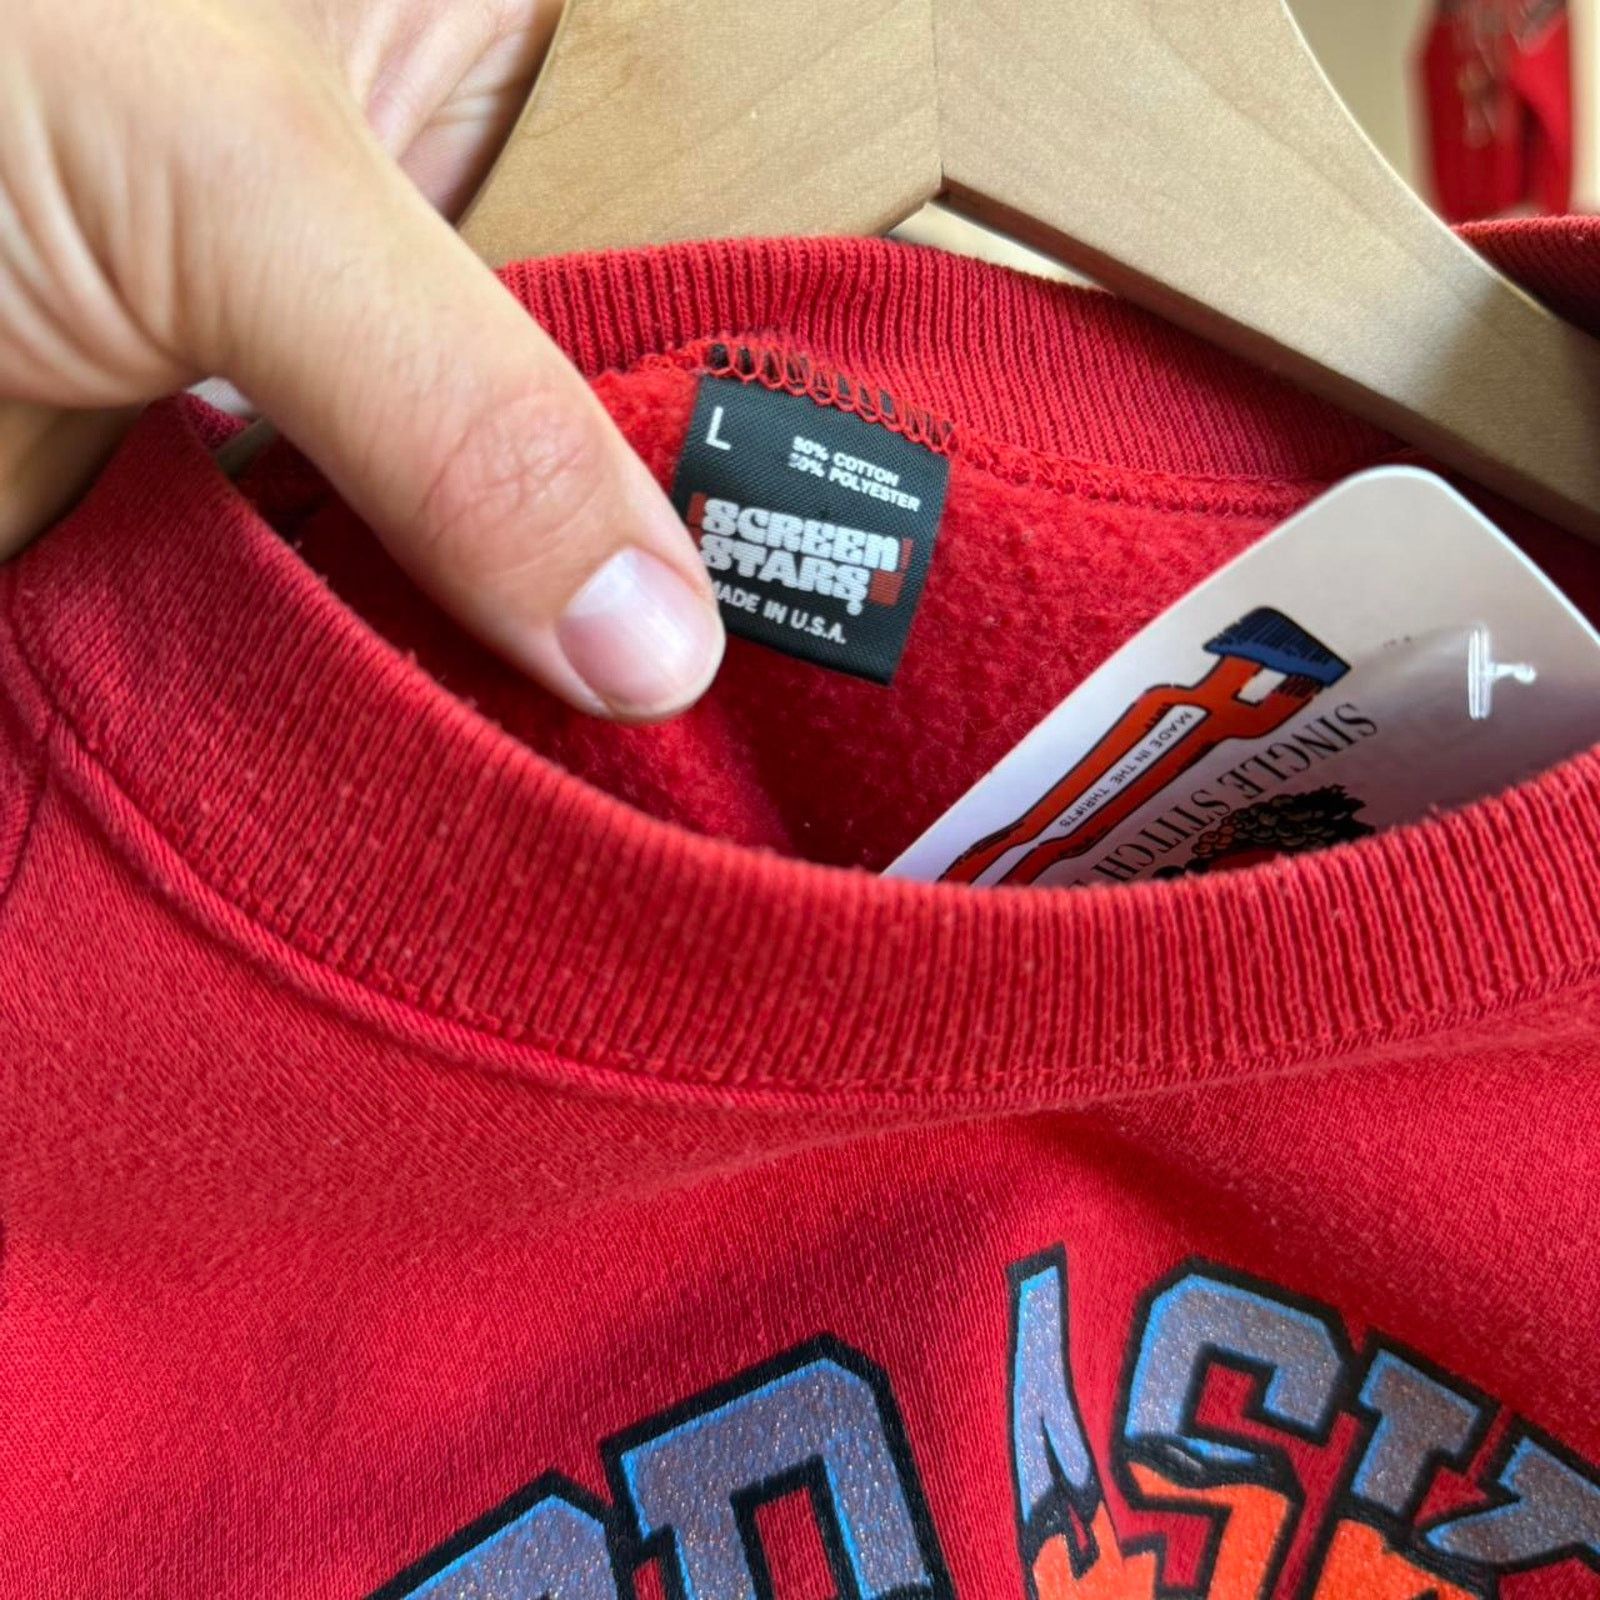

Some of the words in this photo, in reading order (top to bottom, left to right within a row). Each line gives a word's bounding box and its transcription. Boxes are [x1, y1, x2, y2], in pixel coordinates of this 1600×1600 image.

[705, 406, 732, 451] L
[828, 467, 921, 512] POLYESTER
[833, 452, 900, 487] COTTON
[701, 498, 901, 572] SCREEN
[699, 533, 872, 602] STARS
[763, 600, 787, 625] IN
[790, 611, 847, 645] U.S.A.
[1149, 710, 1193, 748] MADE
[1216, 702, 1378, 801] SINGLE
[1110, 763, 1138, 785] THE
[1134, 748, 1152, 763] IN
[1059, 786, 1111, 828] THRIFTS
[1091, 788, 1231, 882] STITCH
